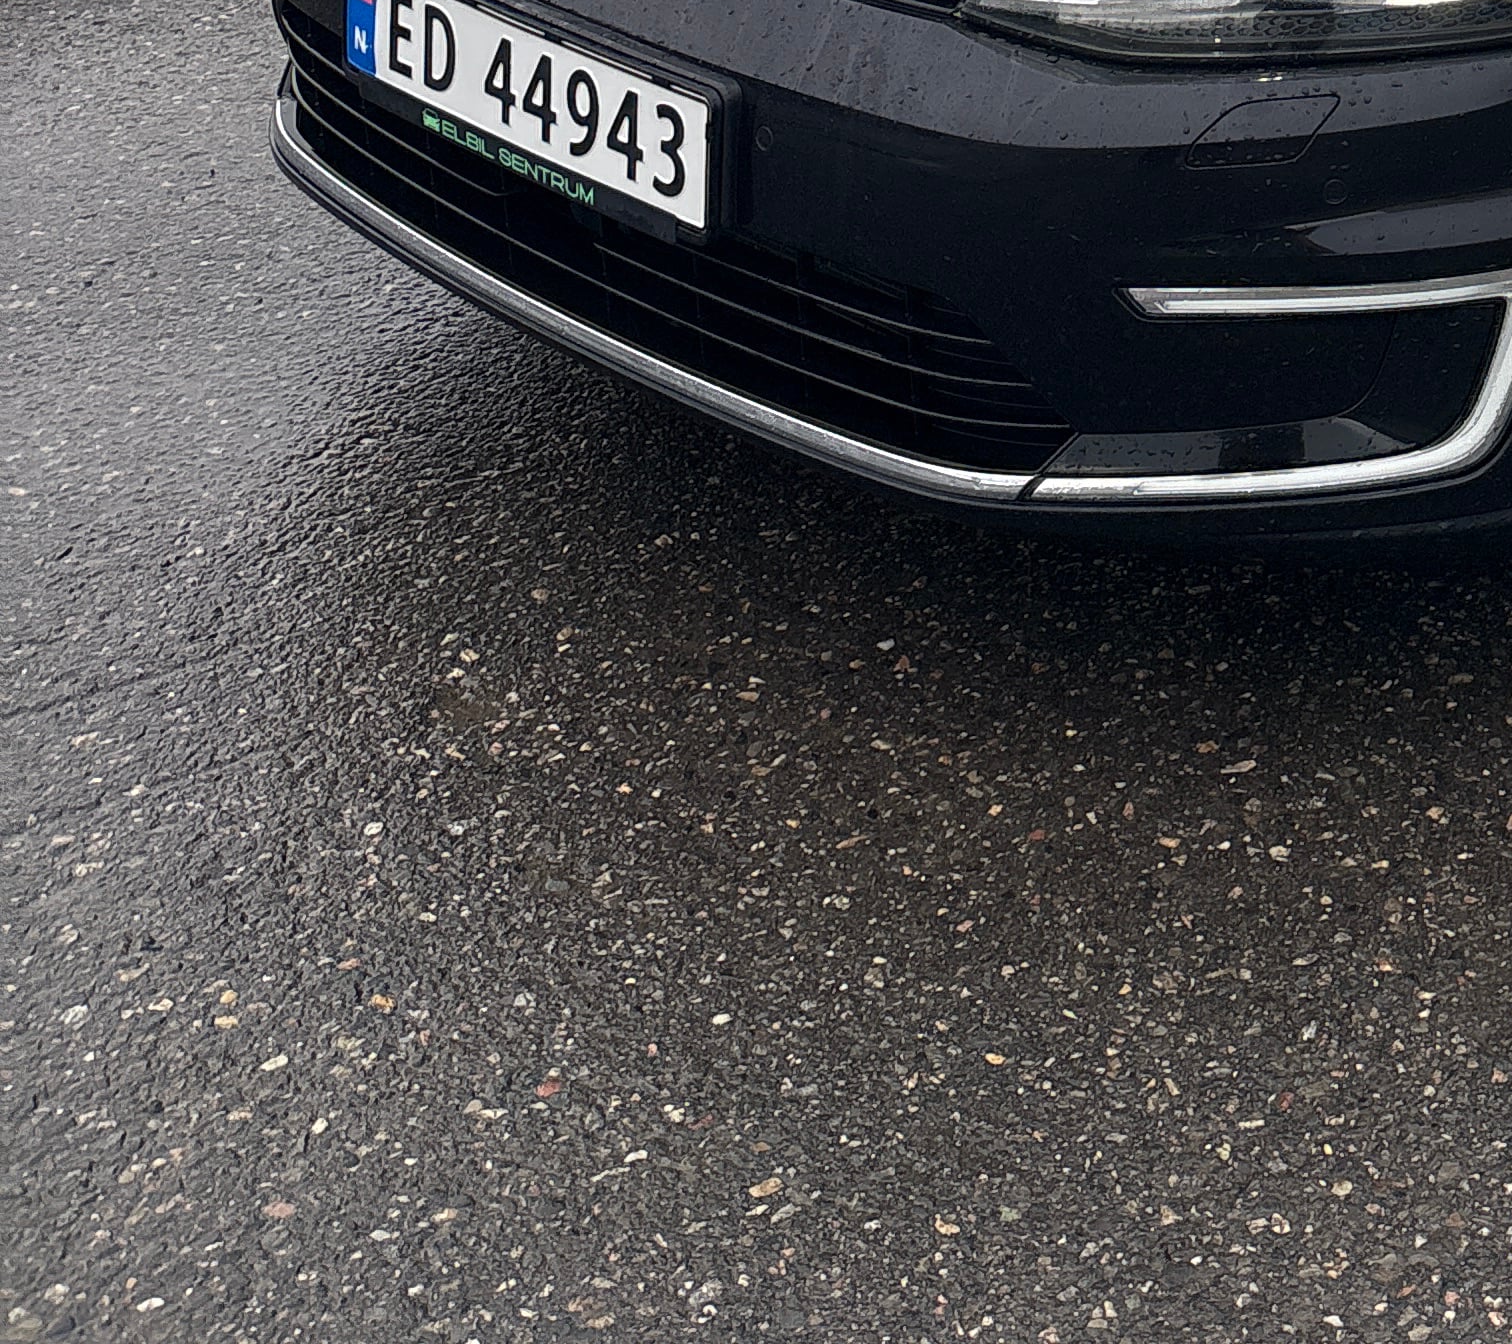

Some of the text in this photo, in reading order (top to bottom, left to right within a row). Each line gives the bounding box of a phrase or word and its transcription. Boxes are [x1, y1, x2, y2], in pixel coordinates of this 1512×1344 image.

[353, 25, 370, 54] N
[484, 37, 687, 198] 44943
[441, 118, 595, 206] ELBIL SENTRUM
